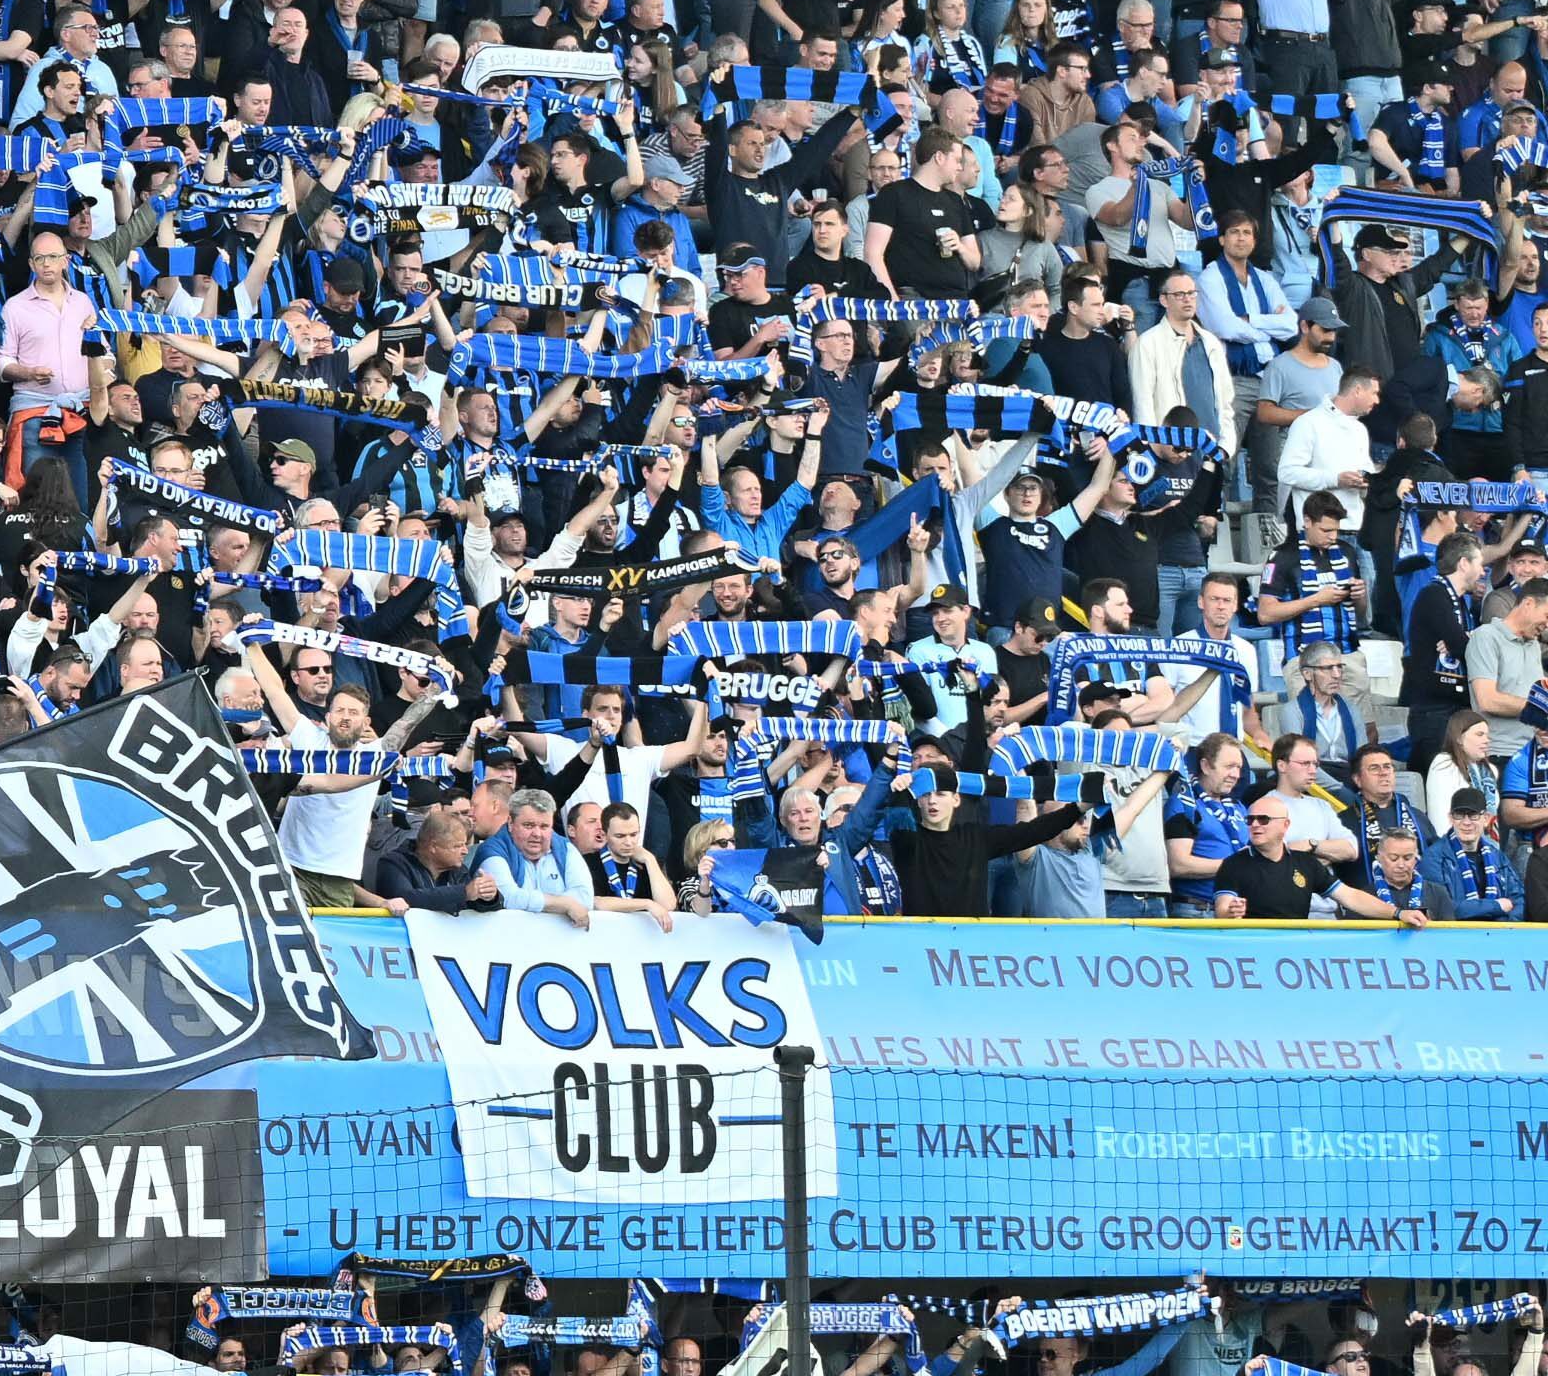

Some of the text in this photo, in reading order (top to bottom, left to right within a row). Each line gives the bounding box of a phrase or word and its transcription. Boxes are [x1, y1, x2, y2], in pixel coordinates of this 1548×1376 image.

[717, 673, 823, 708] BRUGGE
[1076, 955, 1191, 990] VOOR
[1207, 956, 1261, 991] DE
[1274, 956, 1514, 993] ONTELBARE
[433, 954, 789, 1052] VOLKS
[936, 1033, 1403, 1071] WAT JE GEDAAN HEBT!
[265, 1120, 434, 1157] OM VAN
[552, 1061, 718, 1175] CLUB
[849, 1117, 1076, 1160] TE MAKEN!
[329, 1208, 605, 1252] U HEBT ONZE
[951, 1214, 1085, 1252] TERUG
[1099, 1214, 1230, 1252] GROOT
[1246, 1210, 1437, 1254] GEMAAKT!
